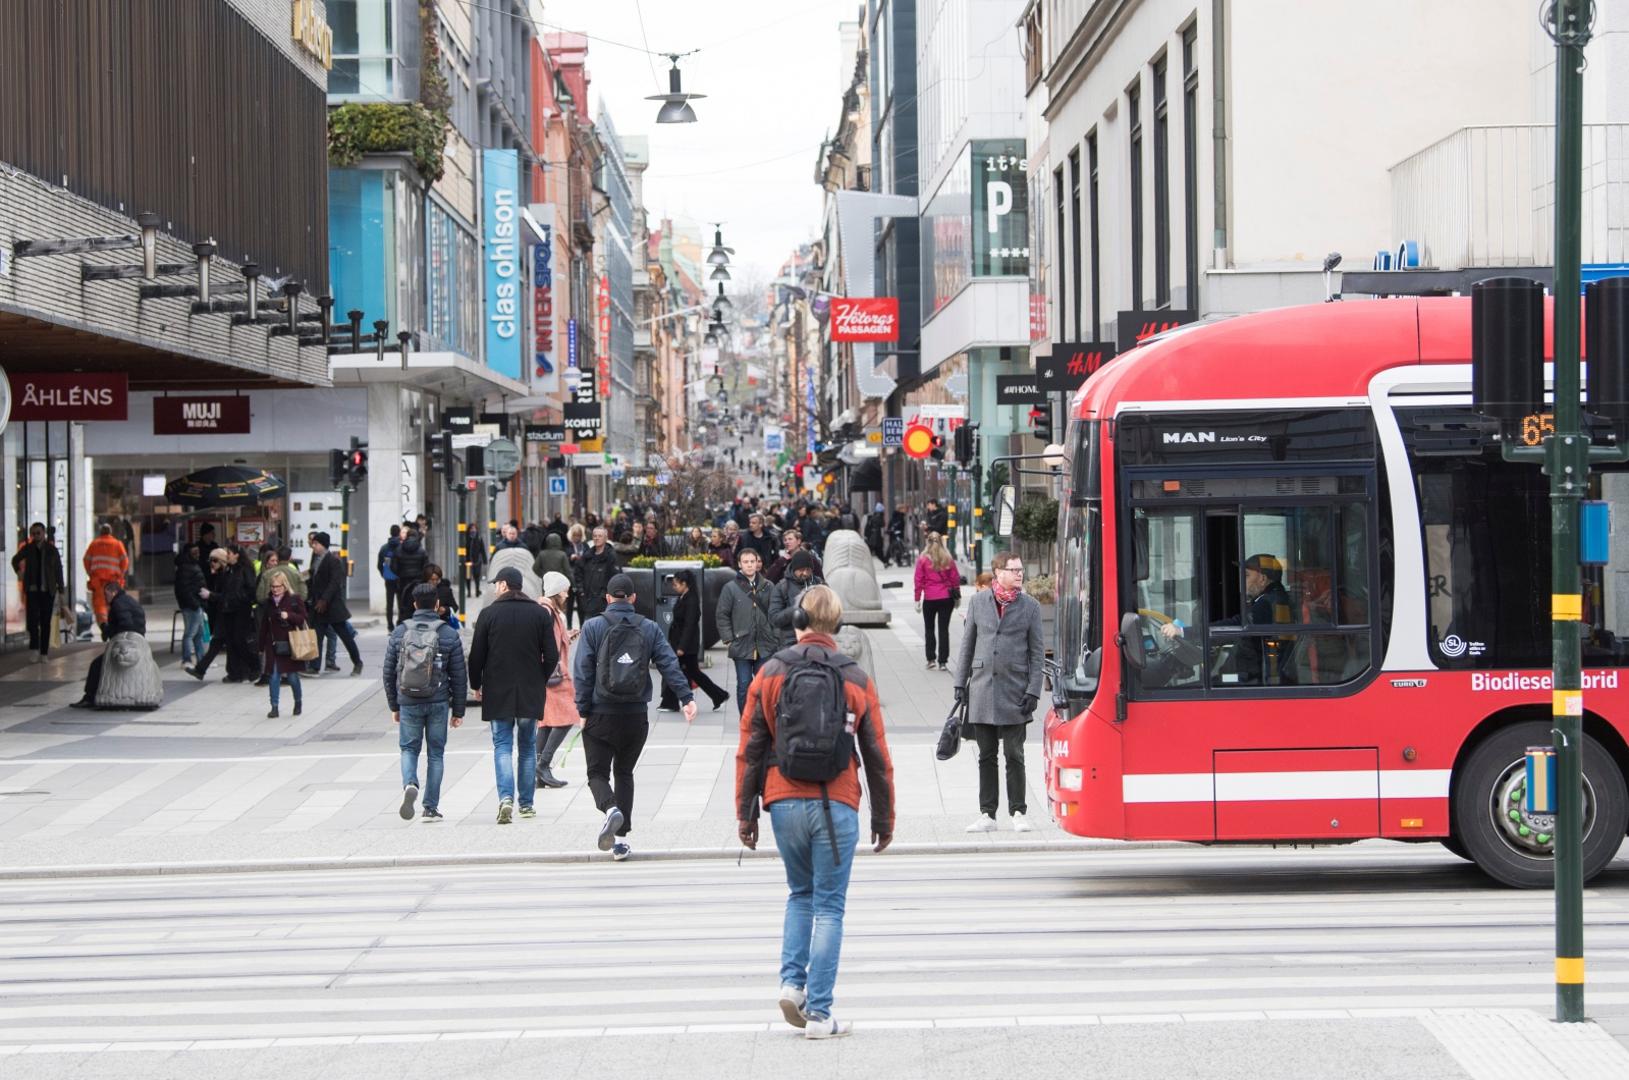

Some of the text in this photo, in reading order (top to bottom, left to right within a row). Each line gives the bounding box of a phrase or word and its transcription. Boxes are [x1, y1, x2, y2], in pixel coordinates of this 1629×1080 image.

[987, 181, 1013, 233] P
[490, 189, 515, 339] clas ohlson
[835, 304, 896, 327] Hötorgs
[838, 325, 892, 334] PASSAGEN
[1066, 351, 1102, 376] H&M
[21, 383, 113, 406] ÅHLÉNS
[183, 403, 221, 419] MUJI
[564, 418, 601, 428] SCORETT
[527, 431, 564, 440] stadium
[1163, 431, 1216, 444] MAN
[1448, 639, 1459, 647] SL
